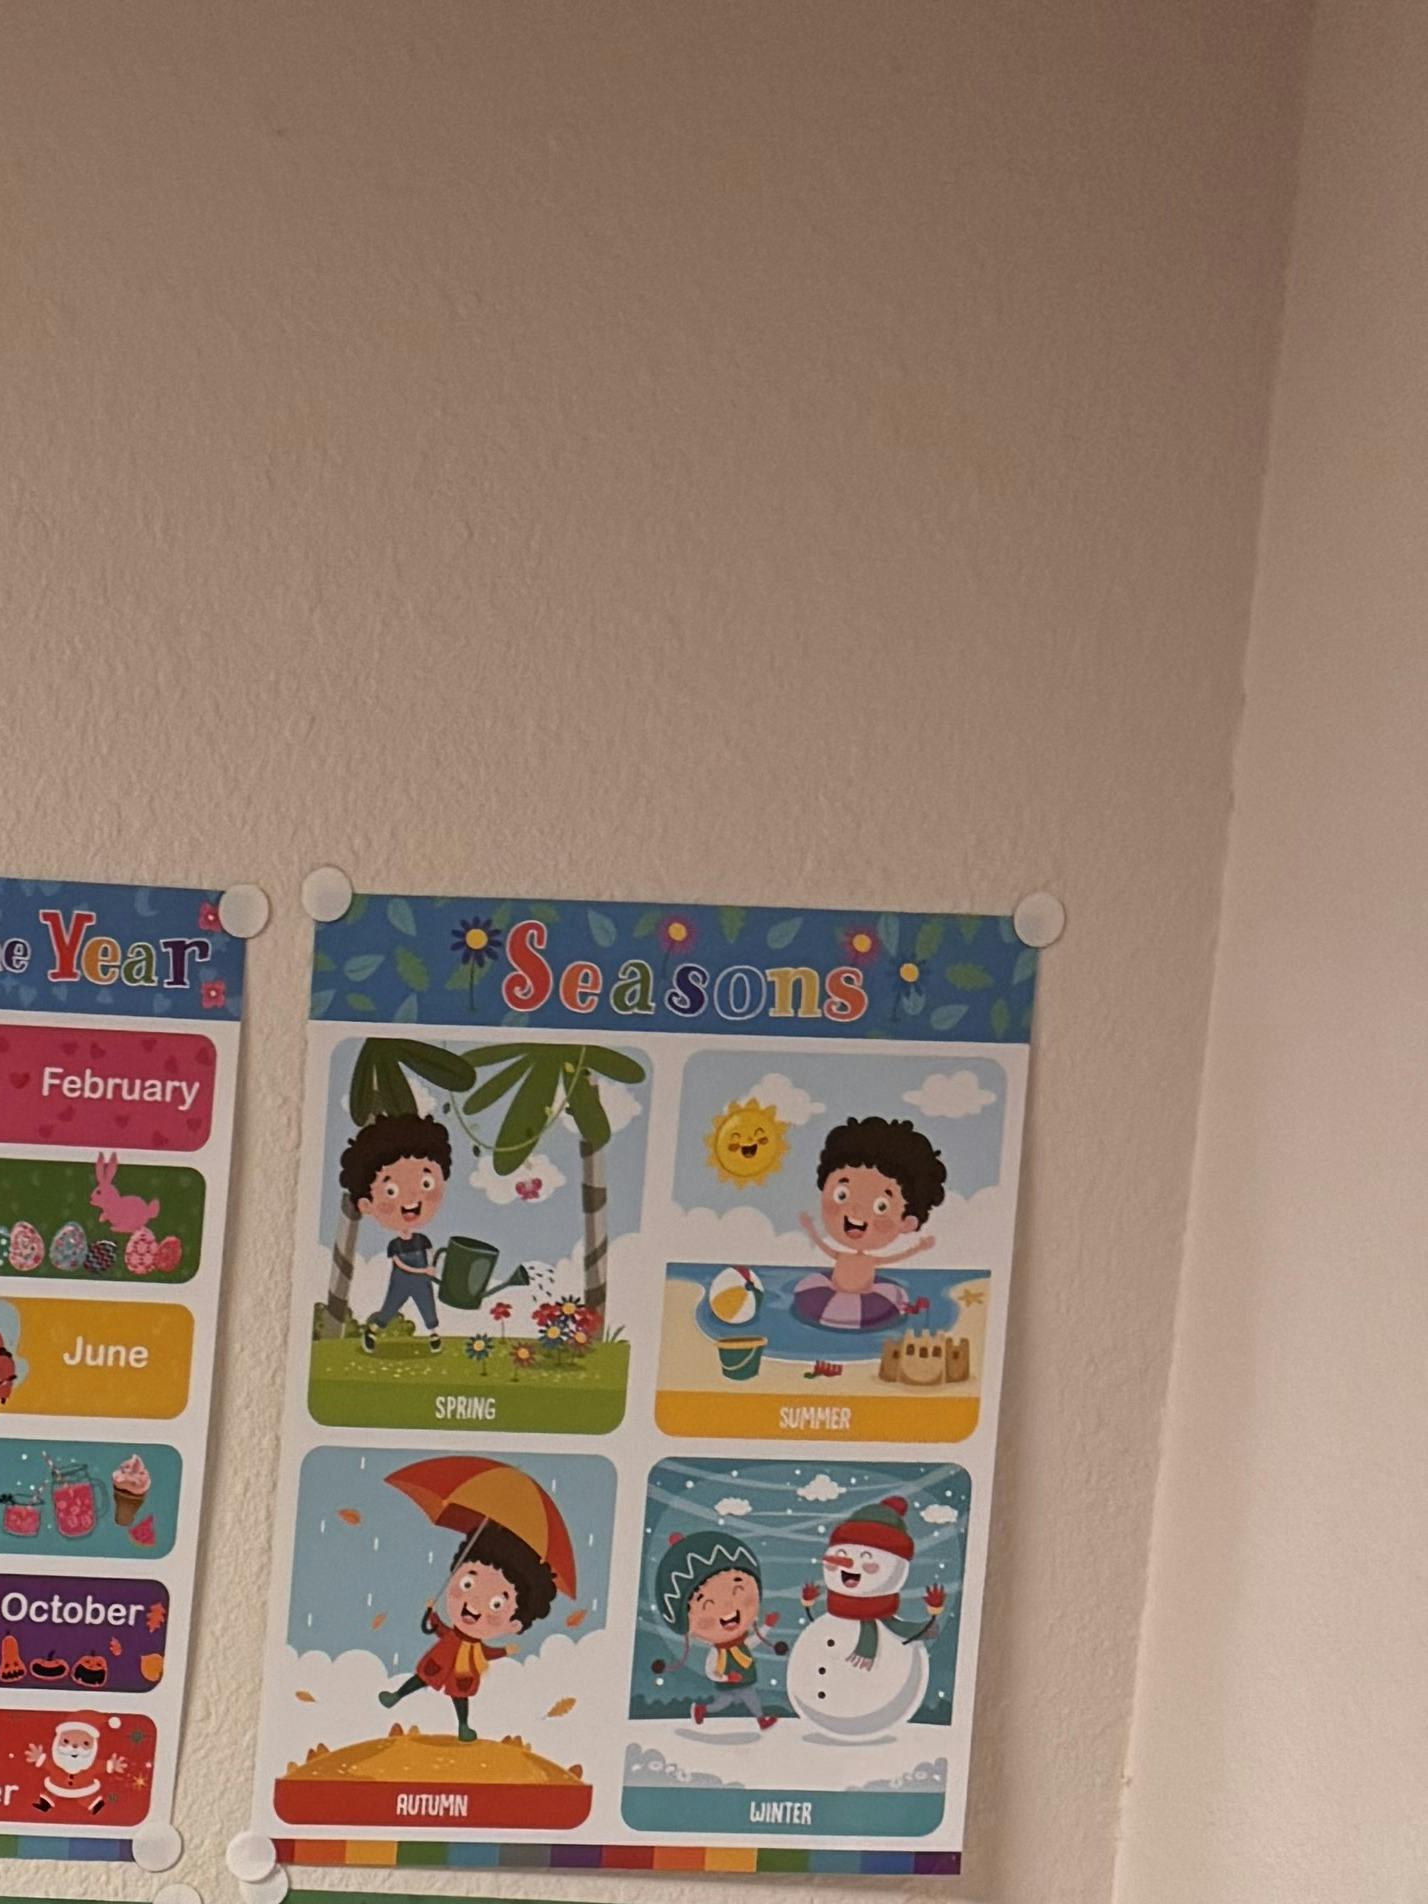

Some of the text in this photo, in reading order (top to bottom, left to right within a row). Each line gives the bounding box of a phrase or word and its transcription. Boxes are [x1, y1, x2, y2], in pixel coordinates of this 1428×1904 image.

[39, 910, 212, 988] Year
[500, 918, 869, 1021] Seasons
[42, 1066, 200, 1111] February
[63, 1336, 149, 1369] June
[435, 1396, 496, 1422] SPRING
[779, 1405, 851, 1430] SUMMER
[0, 1591, 145, 1629] October
[396, 1793, 468, 1818] AUTUMN
[749, 1800, 812, 1826] WINTER
